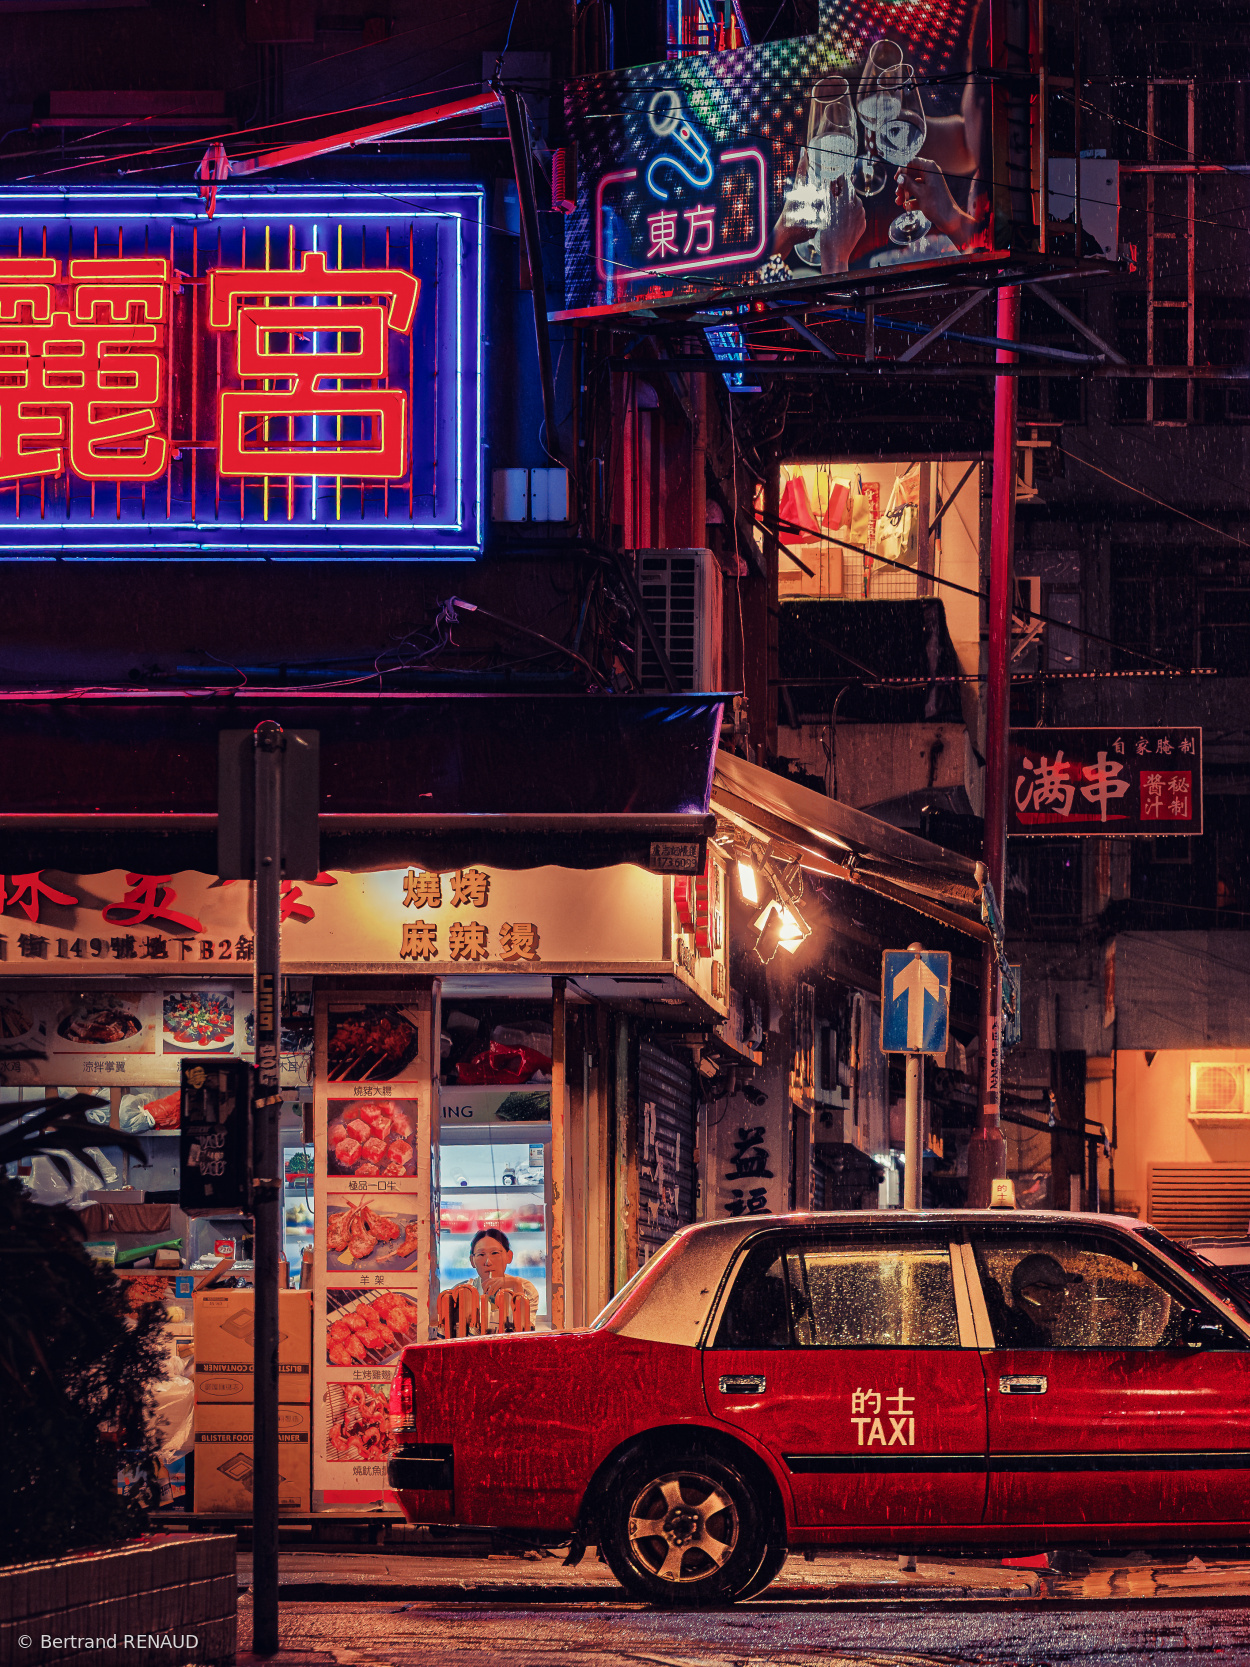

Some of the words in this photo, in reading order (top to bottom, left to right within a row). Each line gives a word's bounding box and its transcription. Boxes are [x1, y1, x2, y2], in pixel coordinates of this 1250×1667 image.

[646, 204, 716, 259] 東方
[402, 869, 491, 909] 燒烤
[400, 919, 541, 962] 麻辣燙
[440, 1105, 474, 1119] ING
[851, 1387, 916, 1415] 的士
[201, 1433, 231, 1442] BLISTER
[850, 1417, 916, 1446] TAXI
